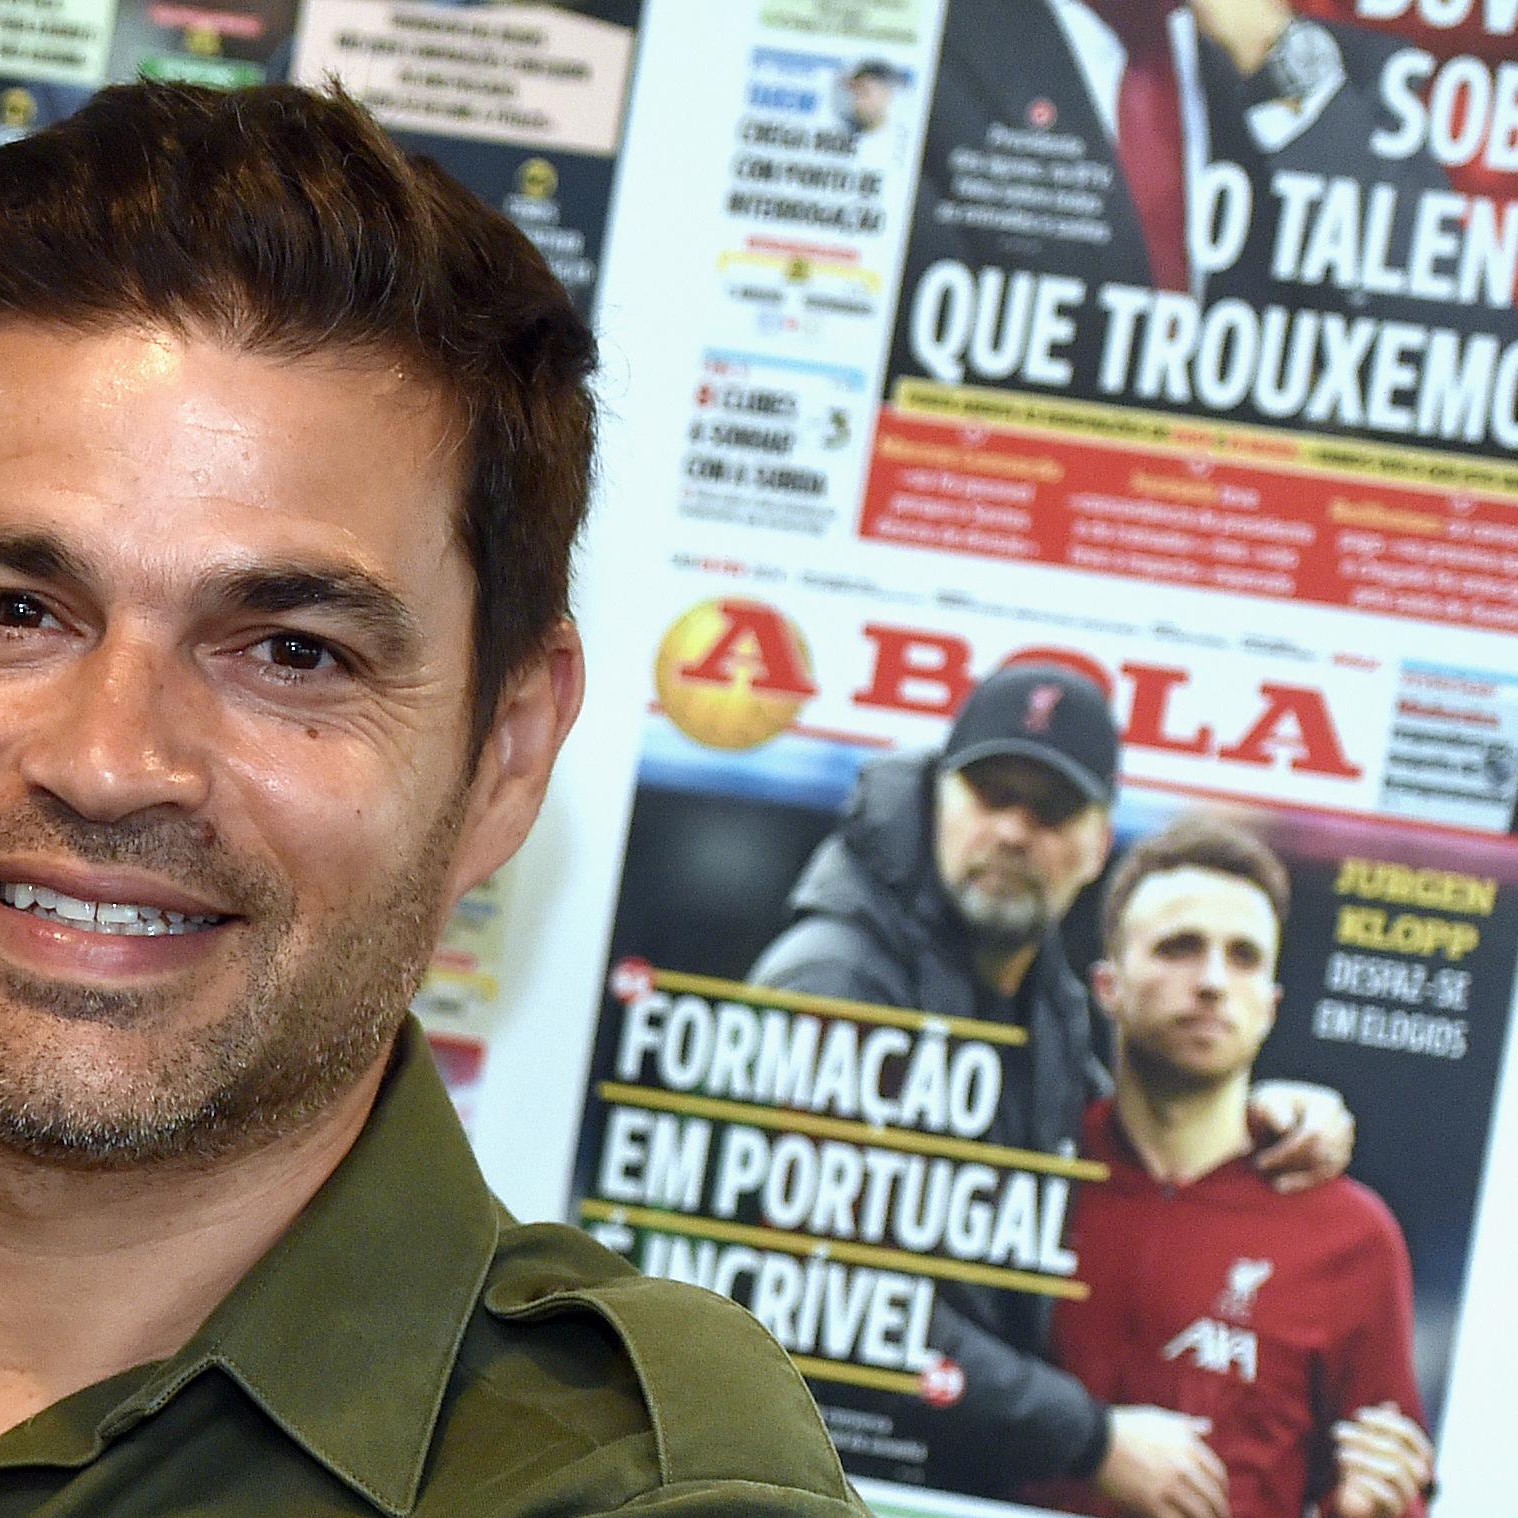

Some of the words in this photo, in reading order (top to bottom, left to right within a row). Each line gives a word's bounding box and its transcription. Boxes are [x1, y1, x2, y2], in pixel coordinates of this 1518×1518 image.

[1192, 159, 1253, 275] O
[1270, 169, 1518, 309] TALEN
[911, 260, 1087, 390] QUE
[680, 598, 817, 697] A
[1326, 951, 1471, 1011] DESFAZ-SE
[1336, 904, 1479, 960] KLOPP
[618, 995, 1004, 1138] FORMAÇÃO
[1313, 999, 1357, 1044] EM
[1362, 1006, 1470, 1058] ELOGIOS
[602, 1111, 709, 1206] EM
[720, 1132, 1079, 1277] PORTUGAL
[643, 1231, 943, 1372] INCRÍVEL
